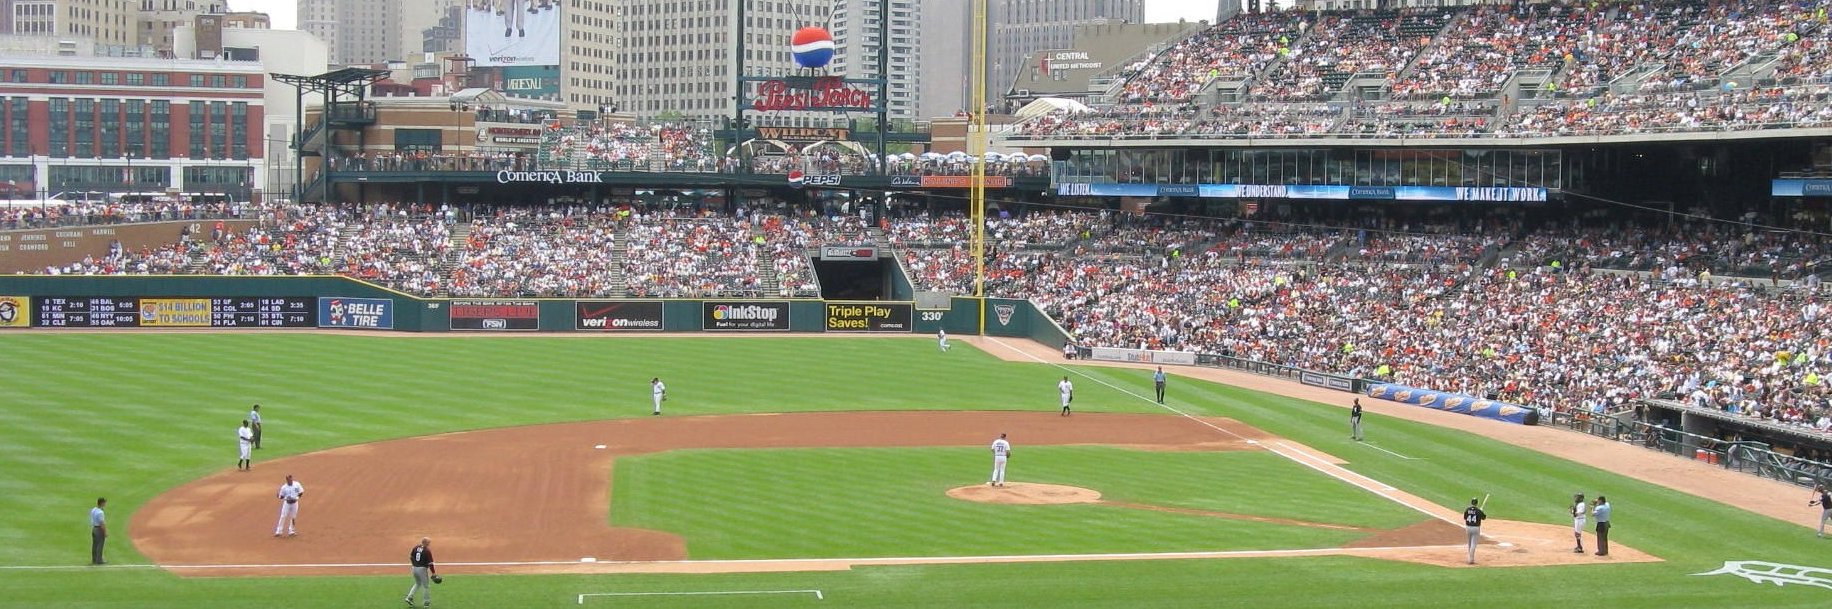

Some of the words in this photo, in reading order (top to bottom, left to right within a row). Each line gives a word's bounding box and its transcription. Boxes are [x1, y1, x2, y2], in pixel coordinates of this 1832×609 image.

[489, 55, 516, 63] verizon
[1056, 52, 1089, 60] CENTRAL
[759, 128, 850, 140] WILDCAT
[566, 170, 603, 183] Bank
[802, 175, 842, 185] PEPSI
[1059, 183, 1070, 196] WE
[1456, 187, 1469, 200] WE
[1472, 187, 1496, 201] MAKE
[1498, 187, 1508, 201] IT
[190, 223, 201, 234] 42
[175, 302, 206, 312] BILLION
[348, 303, 384, 315] BELLE
[829, 306, 862, 318] Triple
[865, 306, 891, 318] Play
[159, 314, 170, 323] TO
[172, 314, 209, 323] SCHOOLS
[728, 305, 778, 322] InkStop
[922, 312, 944, 321] 330'
[352, 315, 379, 326] TIRE
[485, 320, 504, 328] FSN
[583, 317, 628, 328] verizon
[628, 318, 659, 326] wireless
[829, 318, 869, 328] Saves!
[1466, 514, 1477, 523] 44
